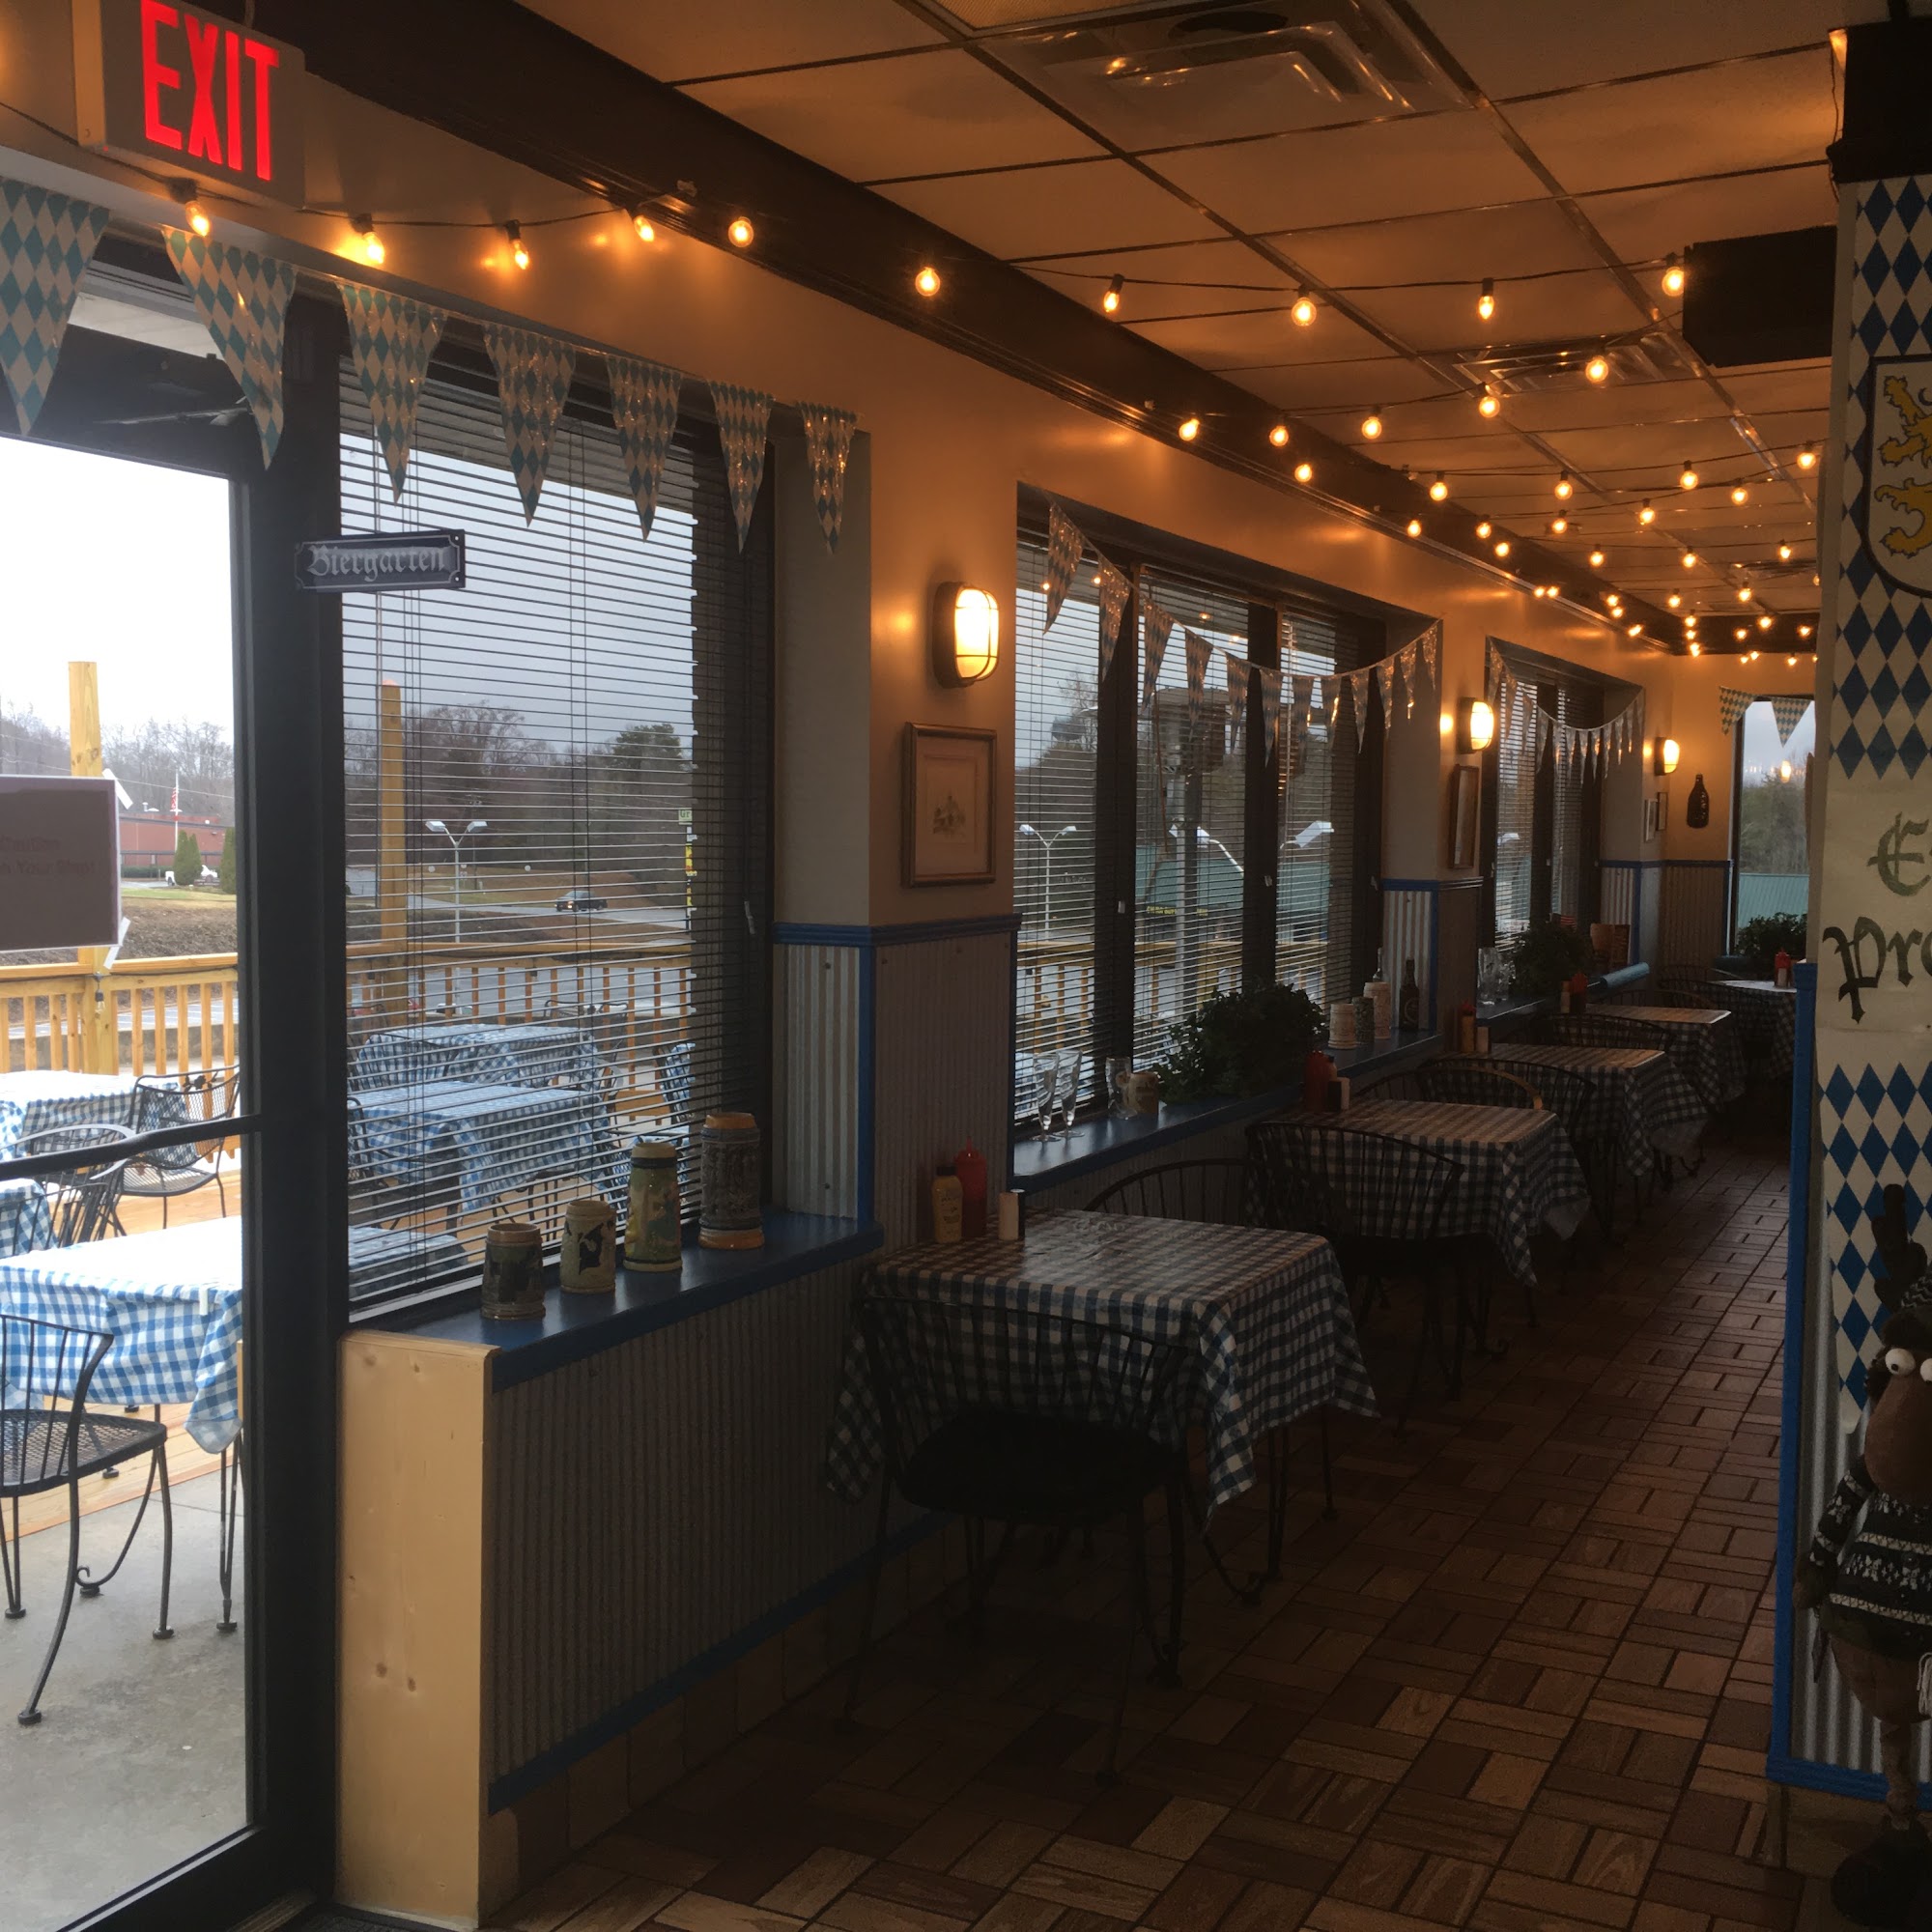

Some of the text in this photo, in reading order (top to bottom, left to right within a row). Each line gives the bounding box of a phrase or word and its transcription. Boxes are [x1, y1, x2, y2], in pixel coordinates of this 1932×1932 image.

[141, 0, 279, 182] EXIT
[306, 544, 447, 582] Biergarten
[1865, 810, 1932, 896] E
